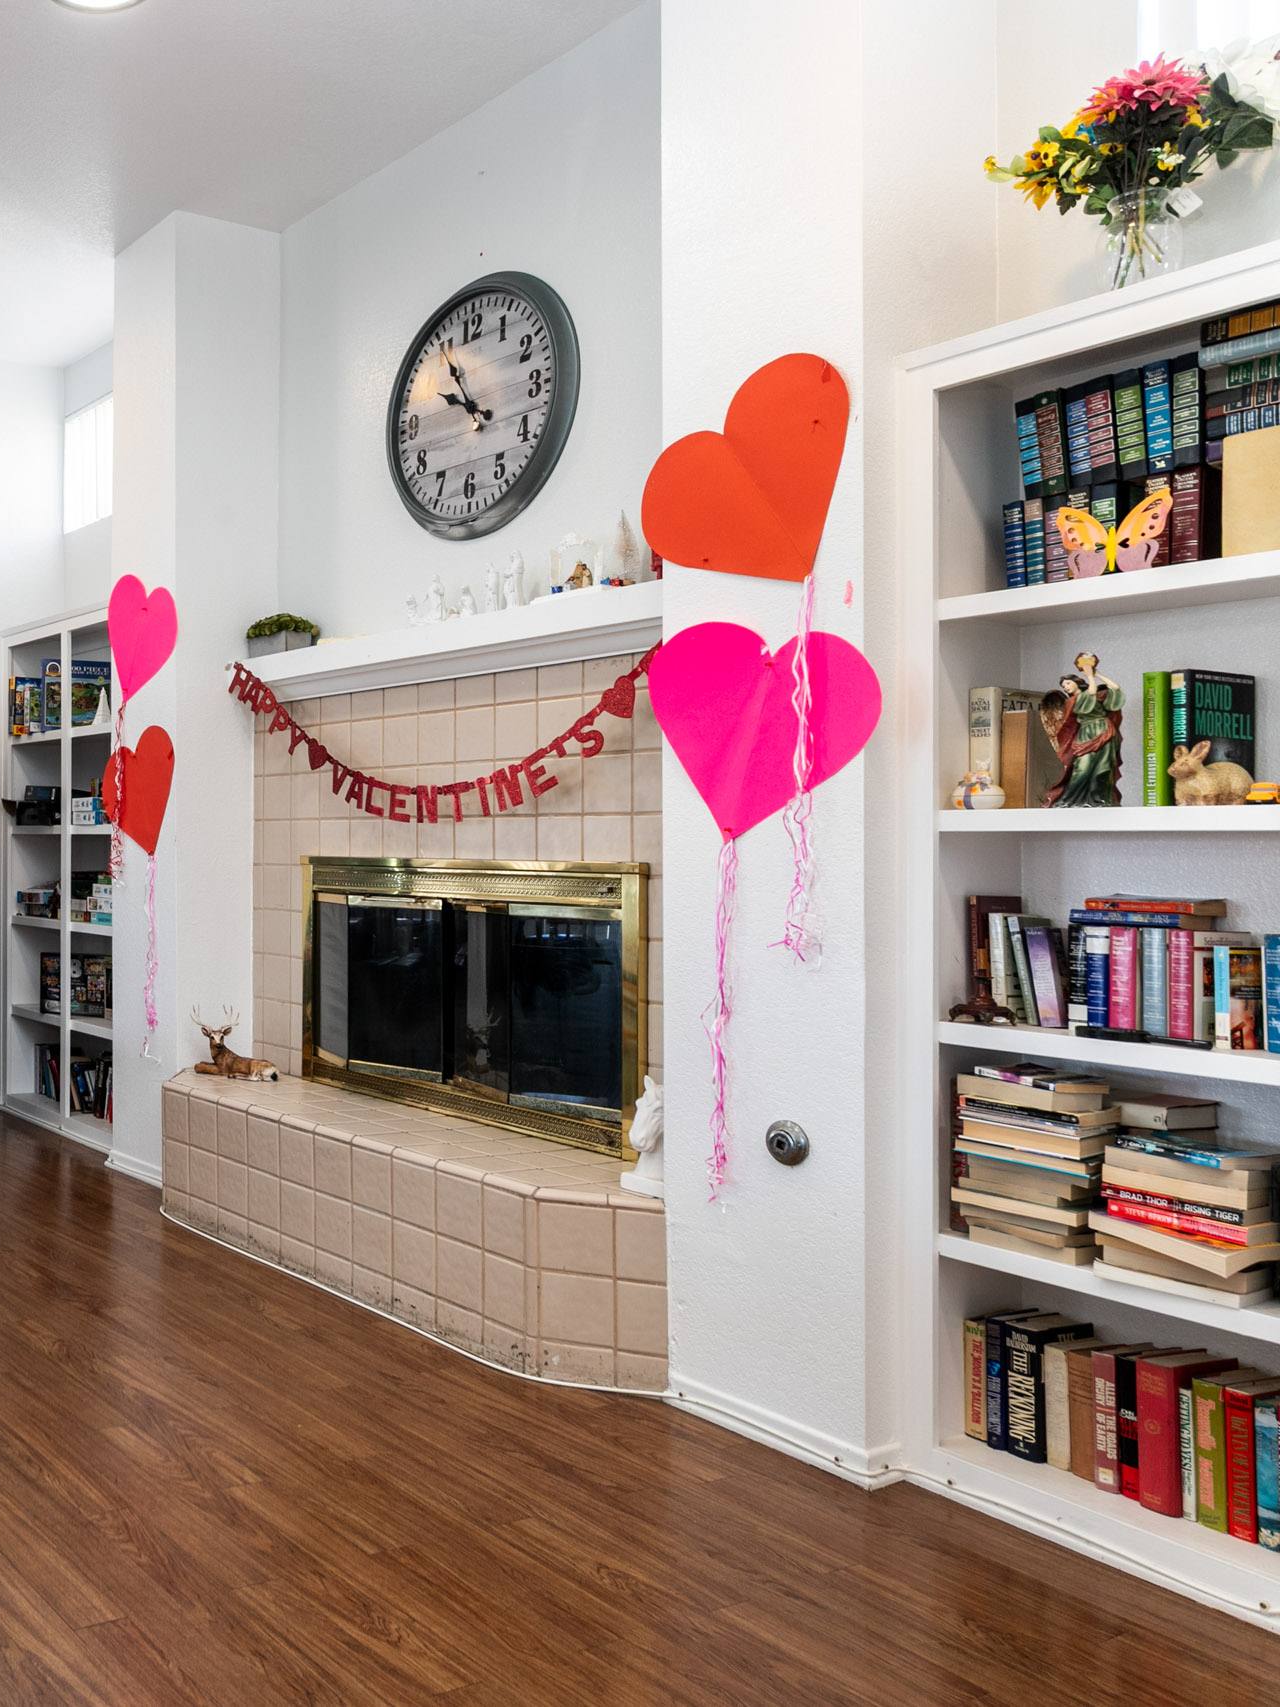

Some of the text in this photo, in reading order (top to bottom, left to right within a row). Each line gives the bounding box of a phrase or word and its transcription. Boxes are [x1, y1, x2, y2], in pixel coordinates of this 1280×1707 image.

[462, 313, 483, 346] 12
[498, 314, 507, 342] 1
[519, 334, 533, 364] 2
[528, 369, 542, 399] 3
[408, 414, 420, 440] 9
[516, 415, 531, 443] 4
[416, 450, 428, 475] 8
[493, 452, 506, 480] 5
[435, 471, 447, 497] 7
[463, 472, 476, 500] 6
[1195, 681, 1233, 711] DAVID
[1173, 707, 1187, 743] MORRELL
[1195, 708, 1254, 740] MORRELL
[228, 663, 605, 824] HAPPY VALENTINE'S
[1147, 752, 1157, 787] Evanovich
[1120, 1190, 1240, 1222] BRAD THOR RISING TIGER
[972, 1339, 982, 1353] THE
[1007, 1350, 1035, 1443] THE RECKONING
[1095, 1377, 1107, 1452] DRURY OF EARTH
[1106, 1381, 1118, 1460] ALLEN THE ROADS
[1179, 1394, 1190, 1435] GETTING
[1180, 1436, 1191, 1448] TO
[1181, 1451, 1192, 1470] YES
